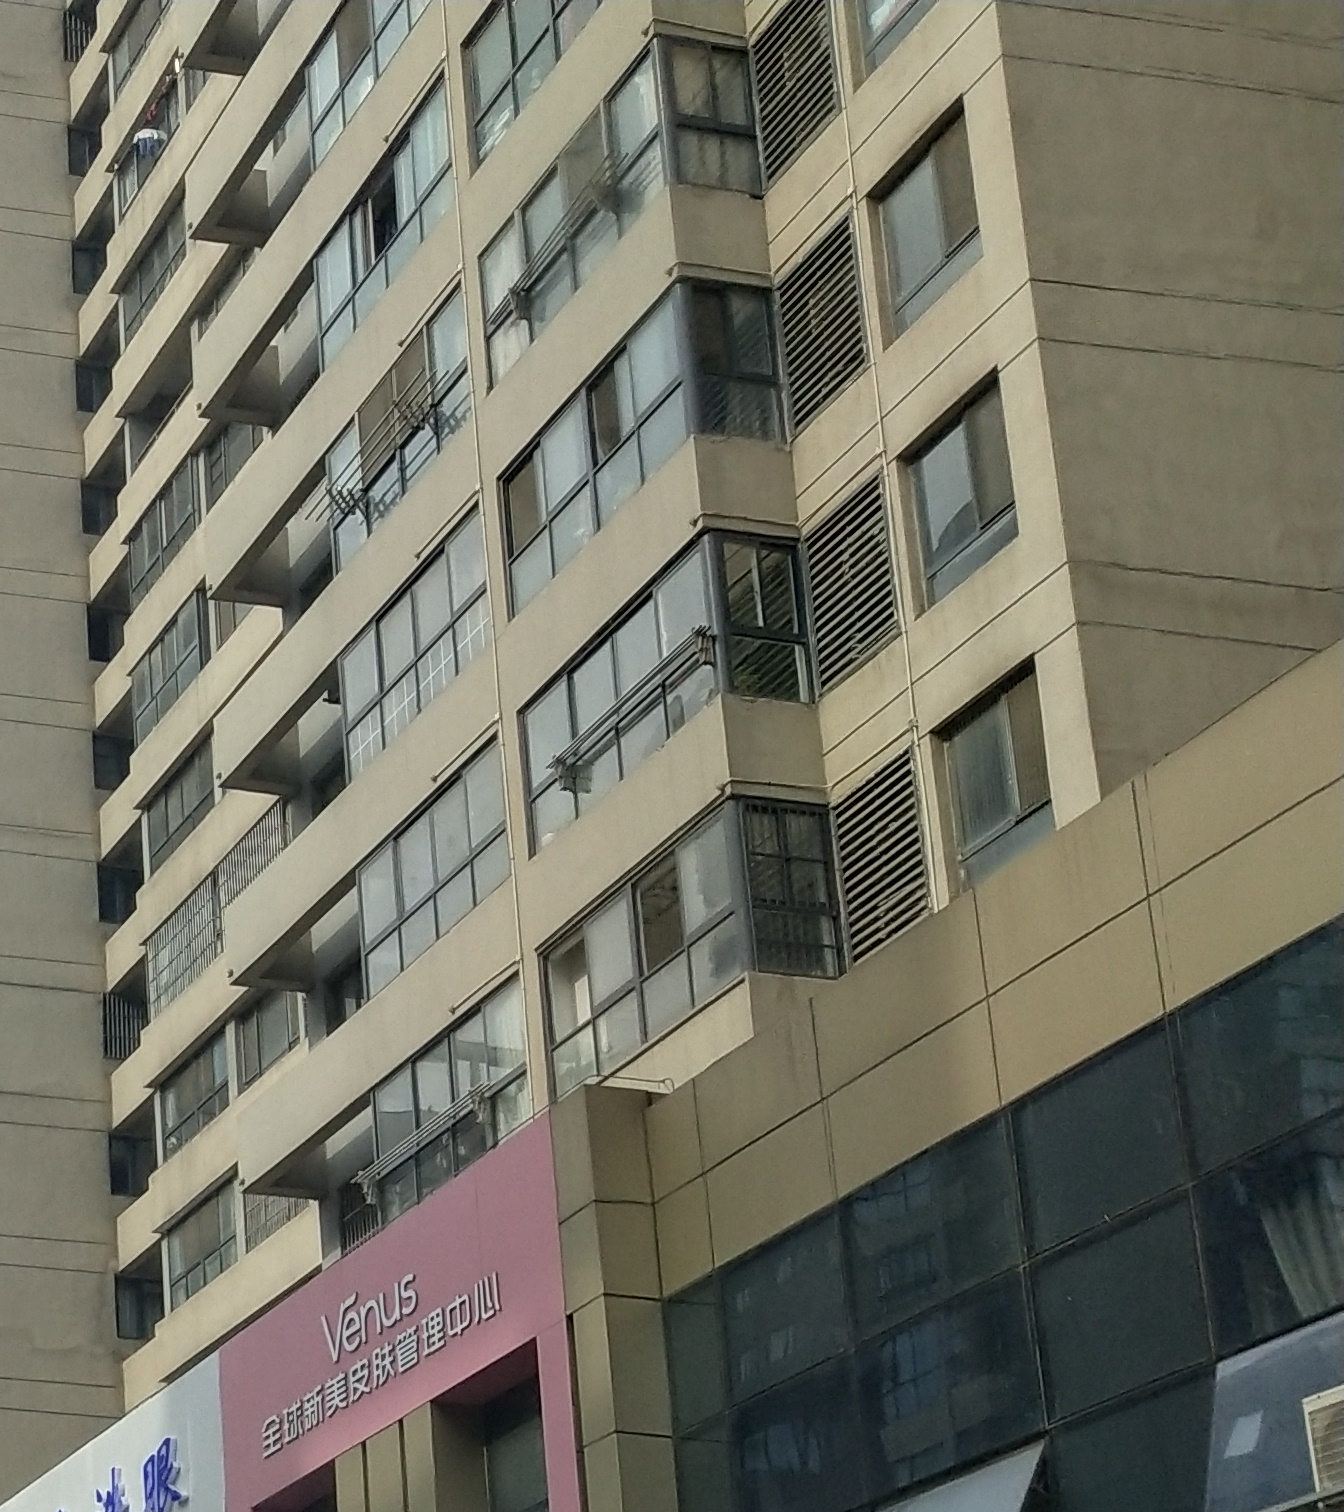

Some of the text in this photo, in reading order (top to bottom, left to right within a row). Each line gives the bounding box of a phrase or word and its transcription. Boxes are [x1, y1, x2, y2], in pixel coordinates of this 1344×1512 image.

[261, 1271, 503, 1459] 全球新美皮肤管理中心
